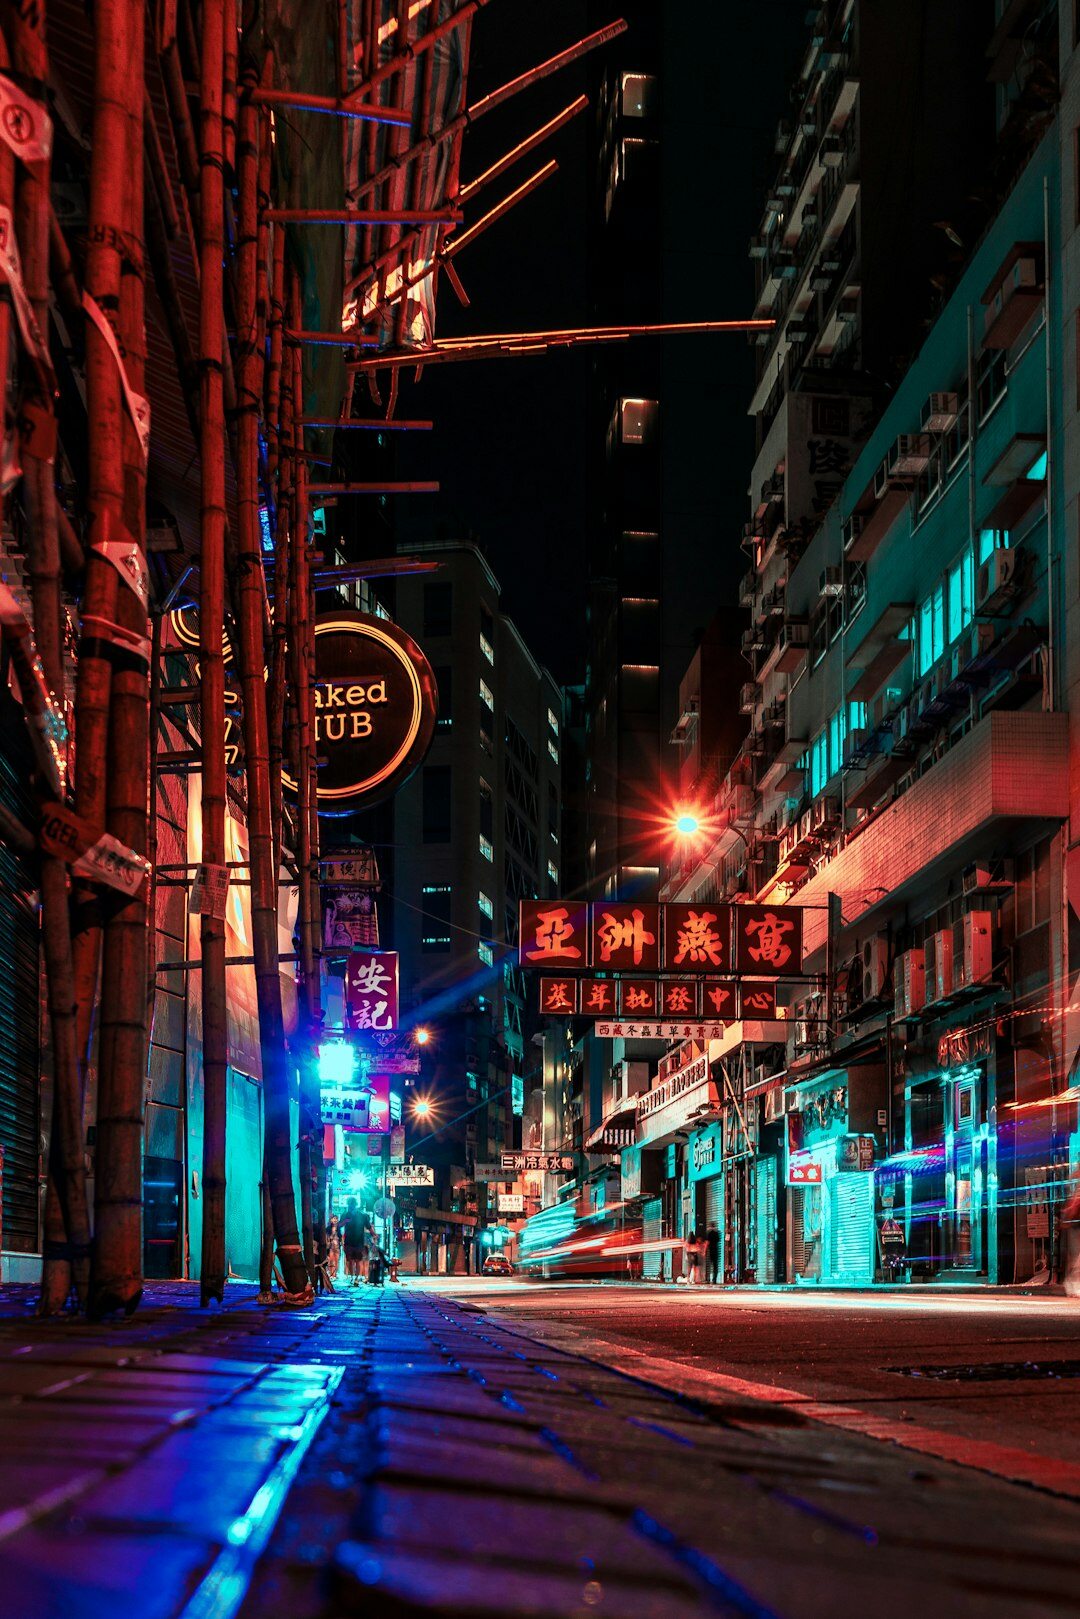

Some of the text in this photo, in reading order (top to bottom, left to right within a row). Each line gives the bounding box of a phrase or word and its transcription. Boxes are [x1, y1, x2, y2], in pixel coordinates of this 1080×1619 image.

[313, 680, 388, 709] aked
[525, 907, 794, 967] 亞洲燕窩
[352, 957, 393, 1030] 安記
[503, 1156, 573, 1170] 三洲冷氣水電
